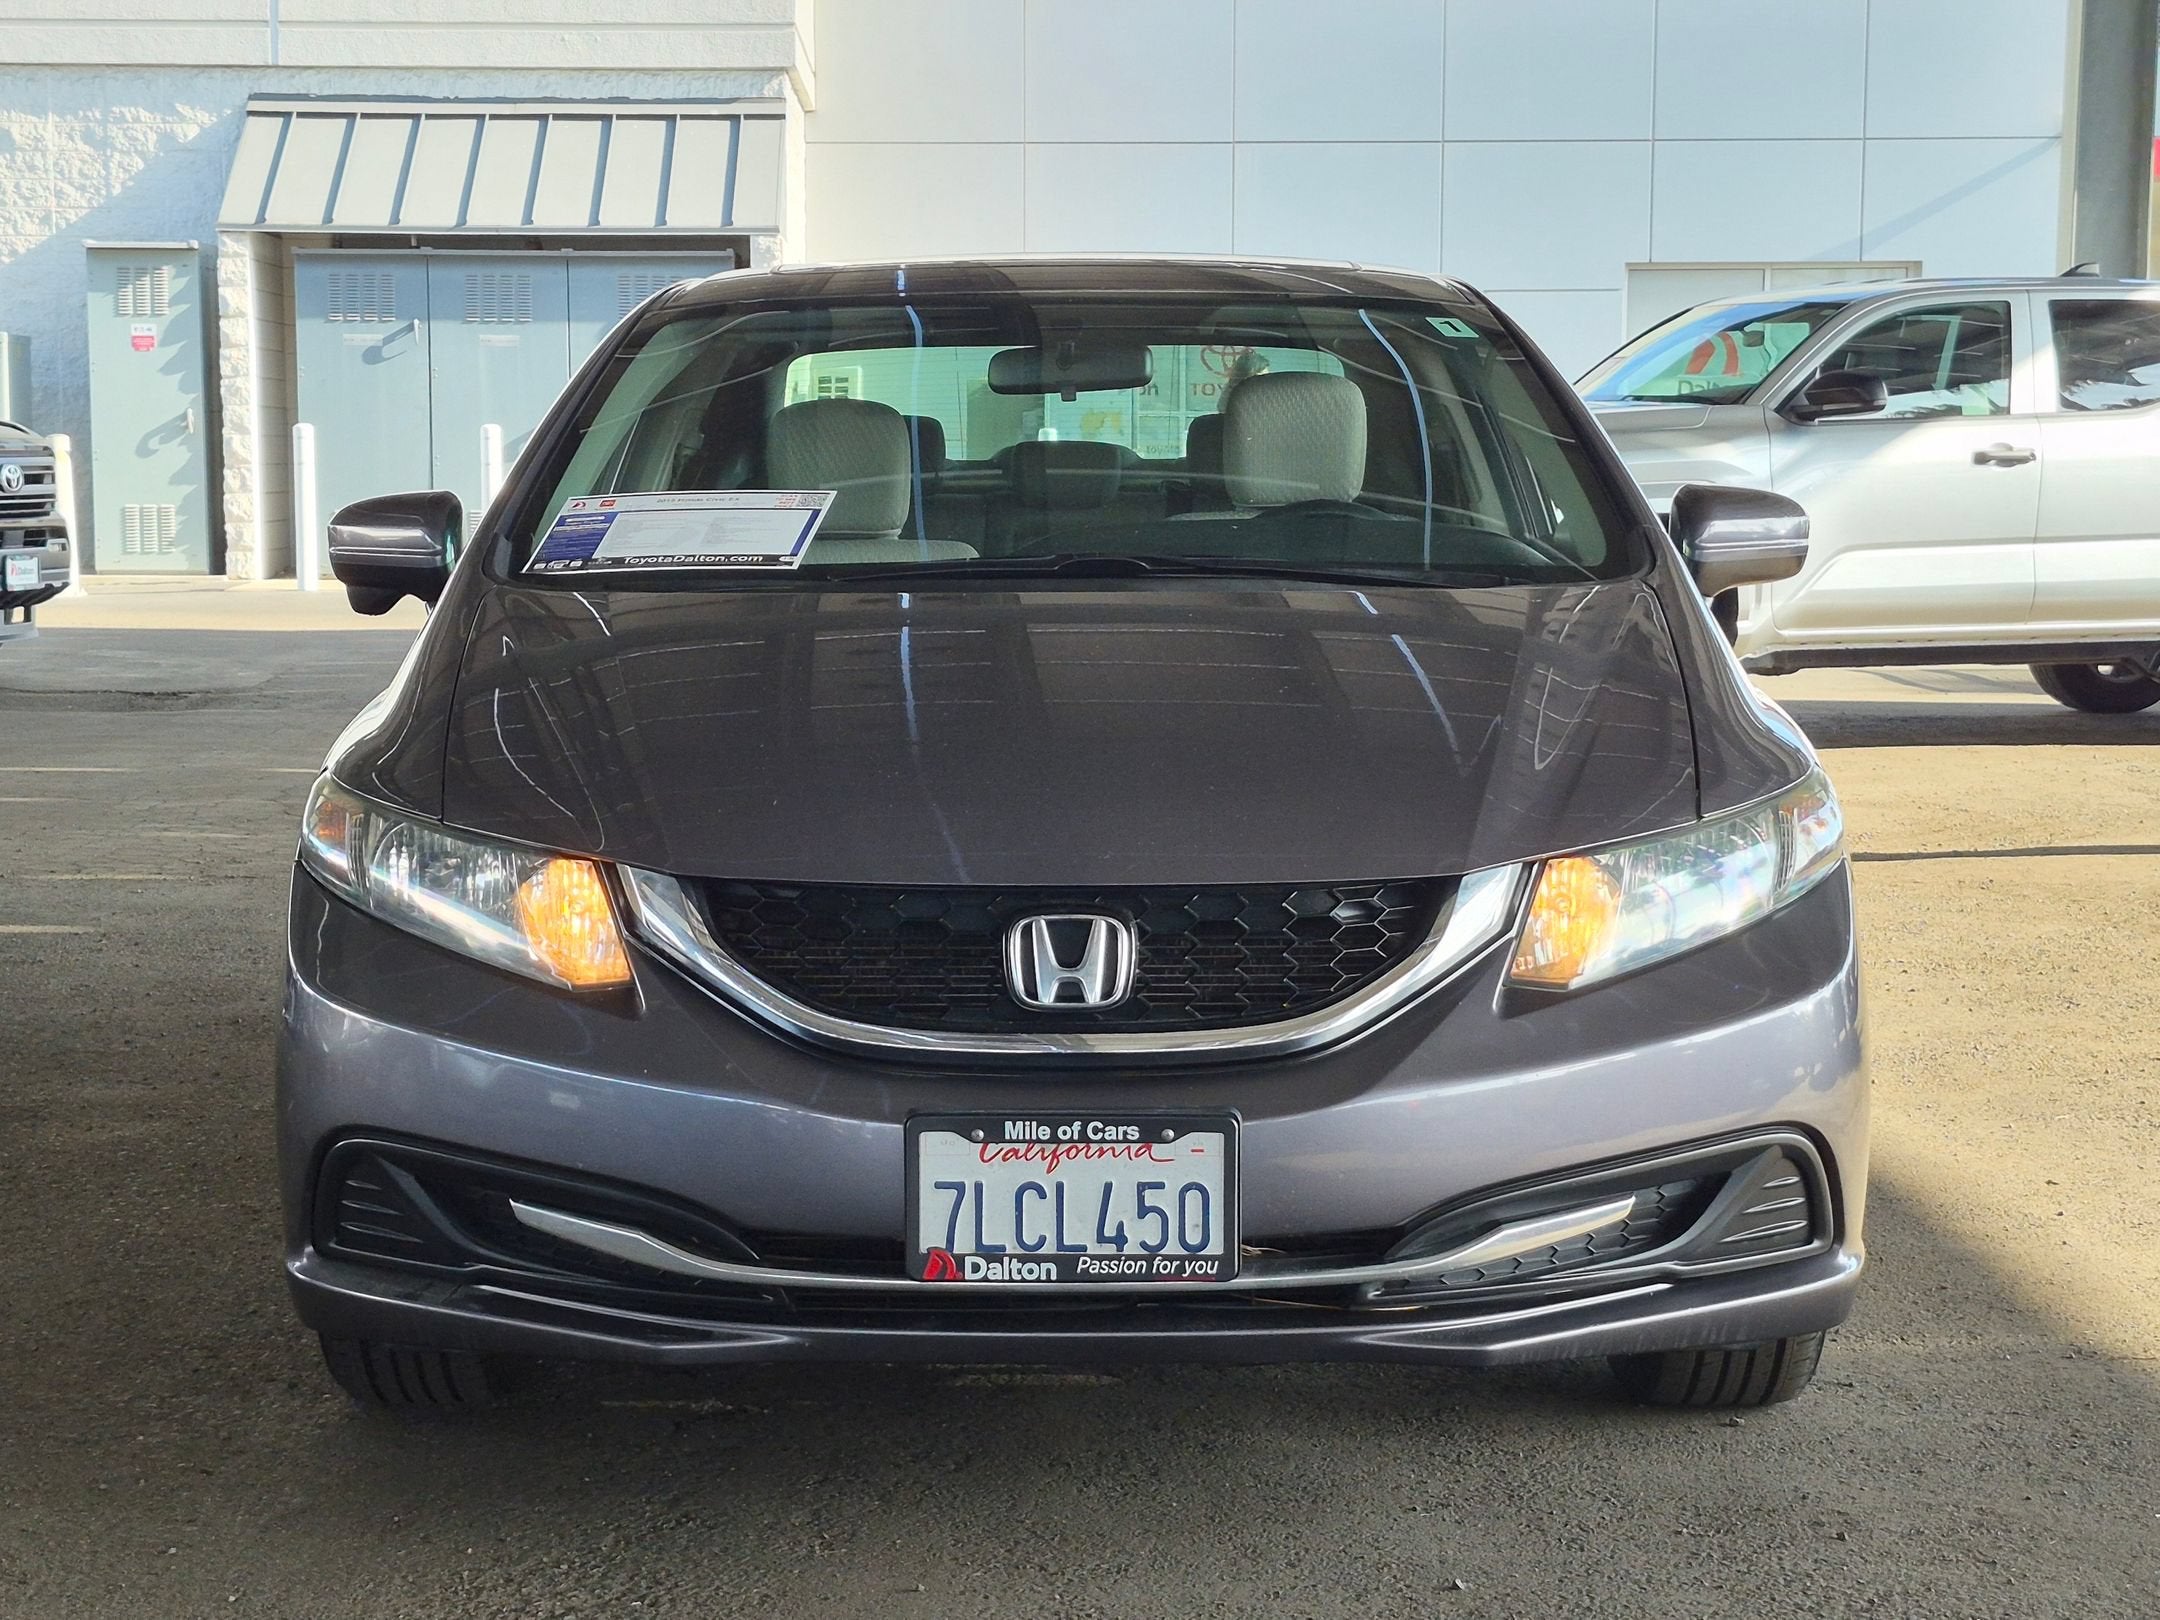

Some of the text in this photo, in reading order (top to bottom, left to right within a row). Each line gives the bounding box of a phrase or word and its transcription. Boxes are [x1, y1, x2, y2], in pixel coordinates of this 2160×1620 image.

[623, 554, 763, 566] ToyotaDalton.com
[1004, 1121, 1140, 1141] Mile of Cars
[979, 1142, 1175, 1174] California
[934, 1180, 1211, 1253] 7LCL450
[964, 1256, 1057, 1281] Dalton
[1076, 1256, 1219, 1277] Passion for you
